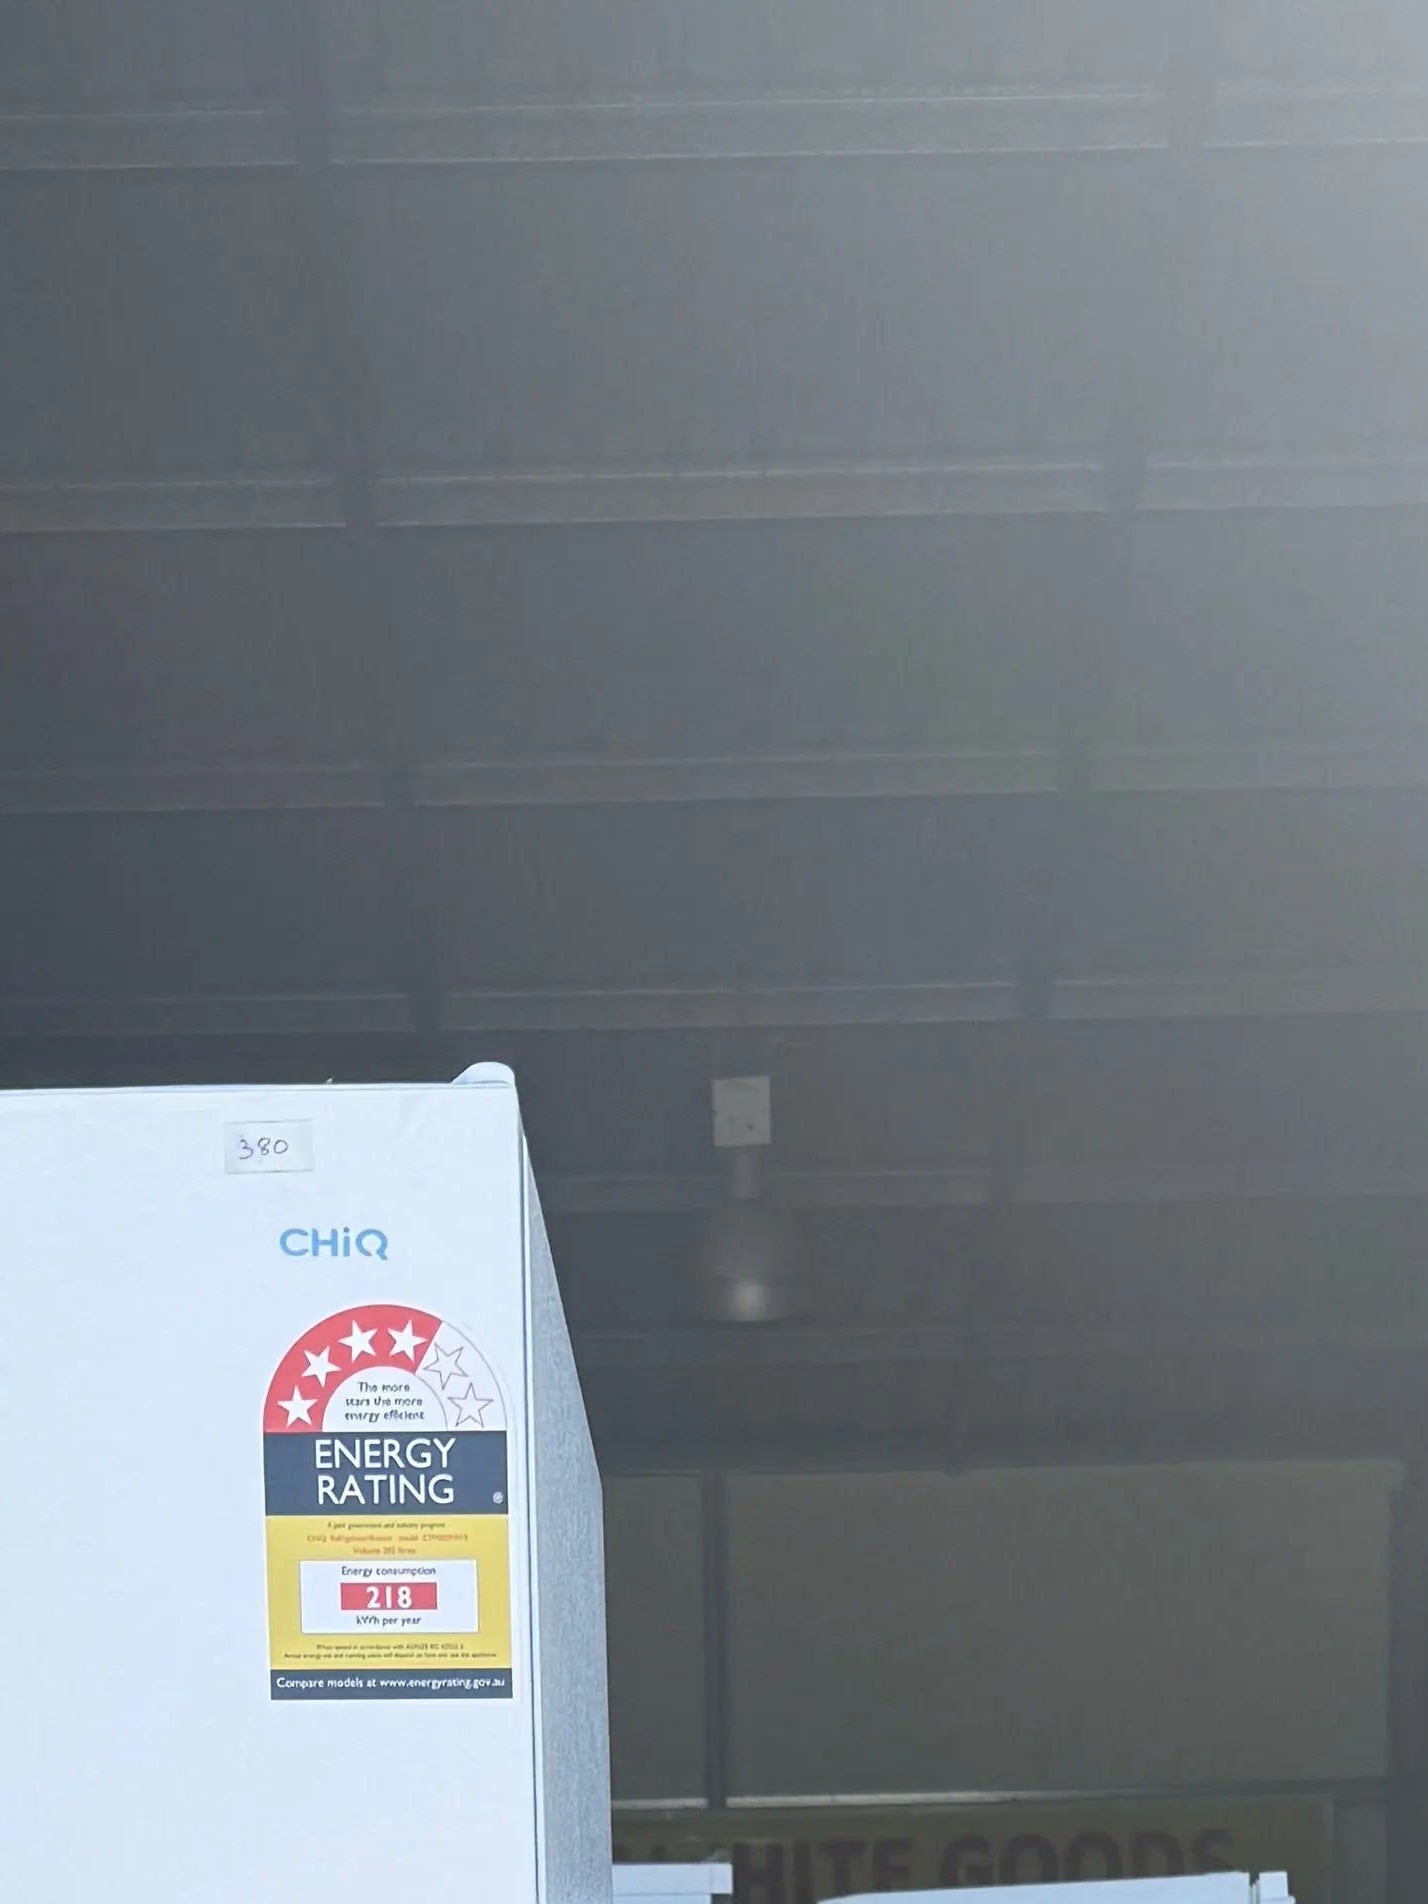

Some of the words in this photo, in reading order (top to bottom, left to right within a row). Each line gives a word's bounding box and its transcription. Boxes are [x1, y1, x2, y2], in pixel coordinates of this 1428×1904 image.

[239, 1137, 289, 1160] 380
[279, 1227, 389, 1261] CHiQ
[357, 1381, 378, 1392] The
[382, 1384, 410, 1392] more
[345, 1412, 379, 1423] energy
[384, 1410, 425, 1420] efficient
[315, 1437, 456, 1469] ENERGY
[318, 1474, 454, 1505] RATING
[341, 1566, 373, 1578] Energy
[376, 1566, 436, 1577] consumption
[366, 1585, 412, 1609] 218
[356, 1616, 379, 1625] kWh
[383, 1618, 398, 1627] per
[401, 1617, 421, 1627] year
[276, 1677, 324, 1690] Compare
[327, 1677, 363, 1688] models
[367, 1678, 376, 1687] at
[380, 1677, 505, 1691] www.energyrating.gov.au
